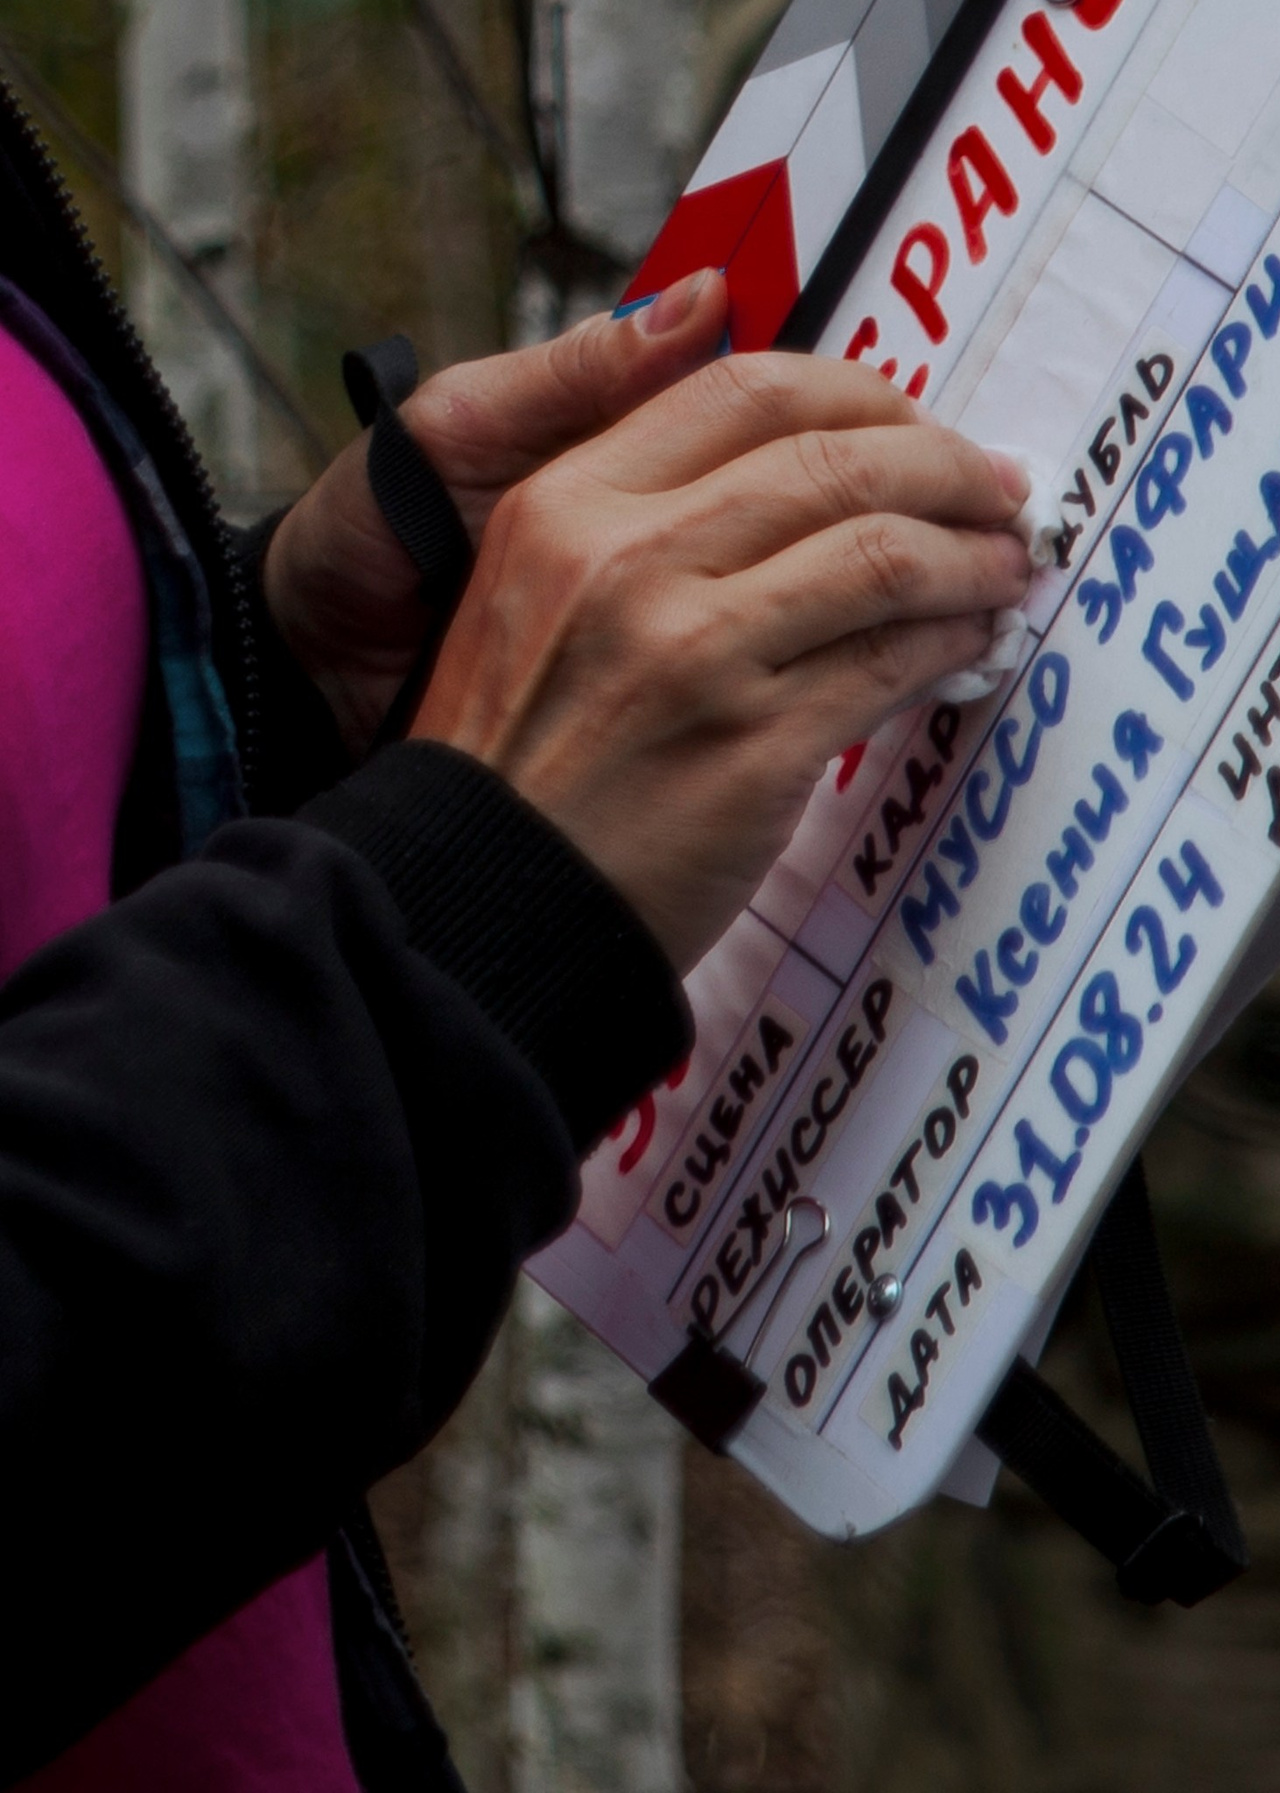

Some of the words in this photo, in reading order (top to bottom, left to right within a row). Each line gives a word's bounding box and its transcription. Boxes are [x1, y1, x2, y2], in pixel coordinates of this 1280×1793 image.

[689, 977, 893, 1333] РЕЖИССЕР
[899, 649, 1070, 966] МУССО
[783, 1054, 979, 1408] ОПЕРАТОР
[956, 708, 1163, 1043] Ксения
[852, 701, 968, 896] КАДР
[663, 1014, 794, 1228] СЦЕНА
[886, 1247, 981, 1450] ДАТА
[975, 838, 1224, 1248] 31.08.24
